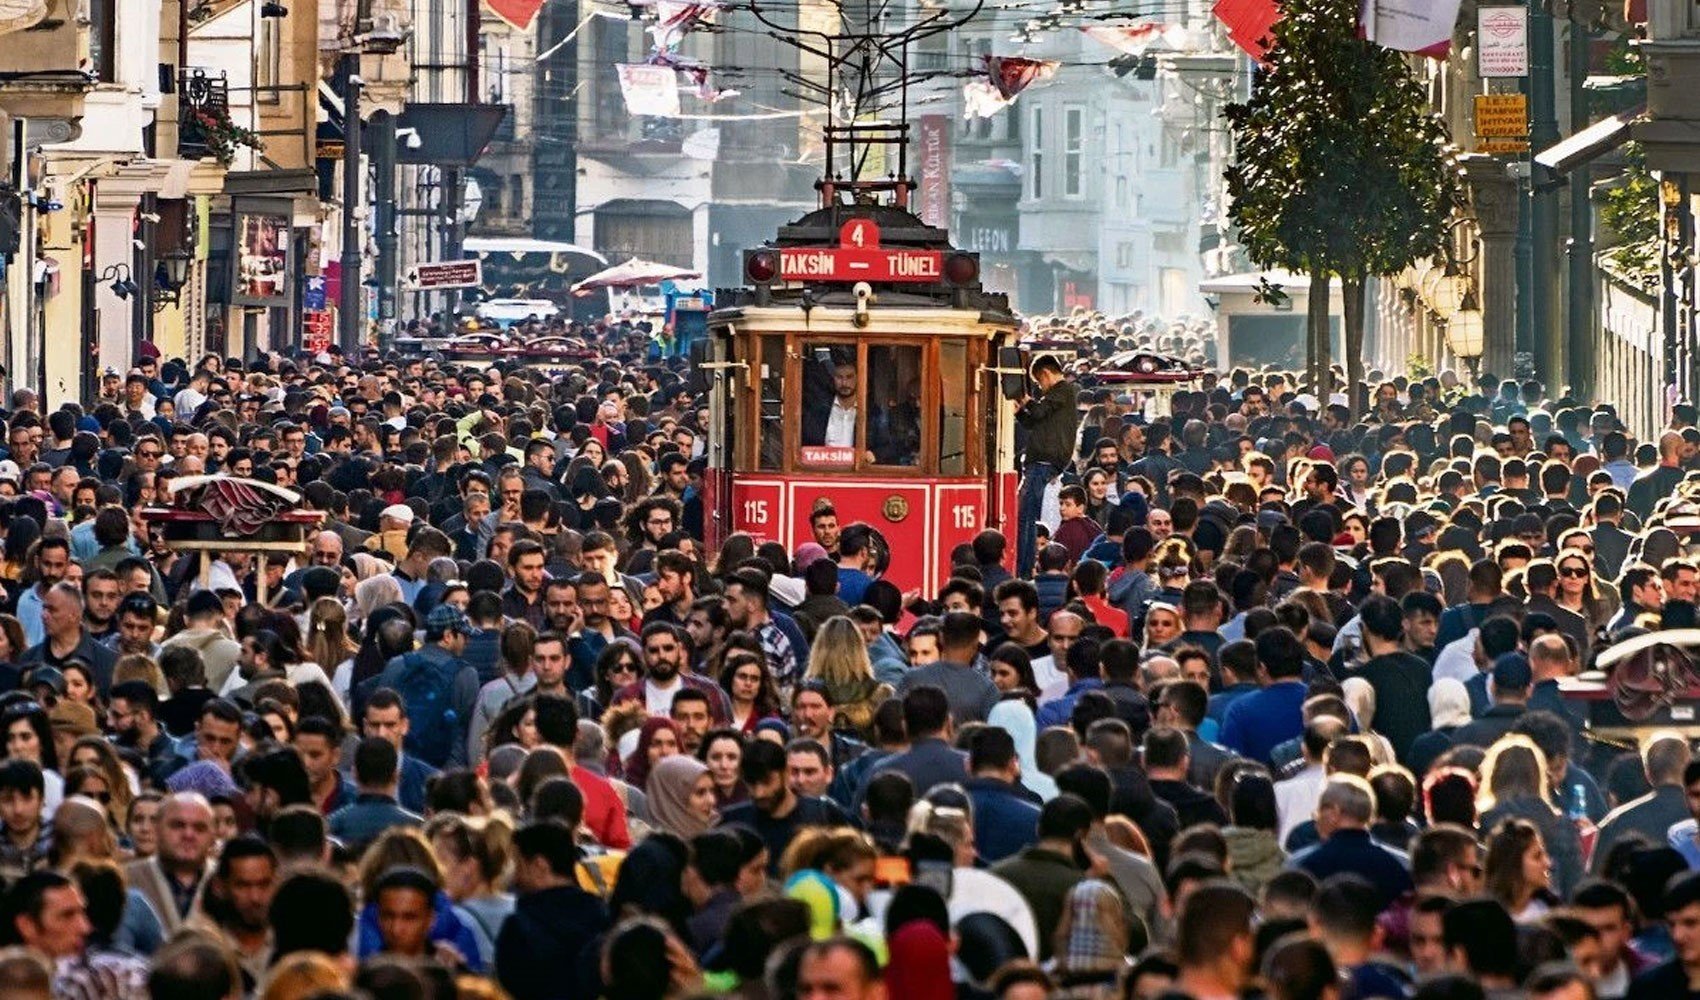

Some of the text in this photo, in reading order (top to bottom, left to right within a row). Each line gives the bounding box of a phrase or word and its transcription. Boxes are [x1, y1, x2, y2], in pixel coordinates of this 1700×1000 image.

[1482, 127, 1522, 136] DURAK
[851, 224, 864, 247] 4
[886, 252, 940, 276] TÜNEL
[744, 501, 768, 524] 115
[953, 505, 975, 528] 115
